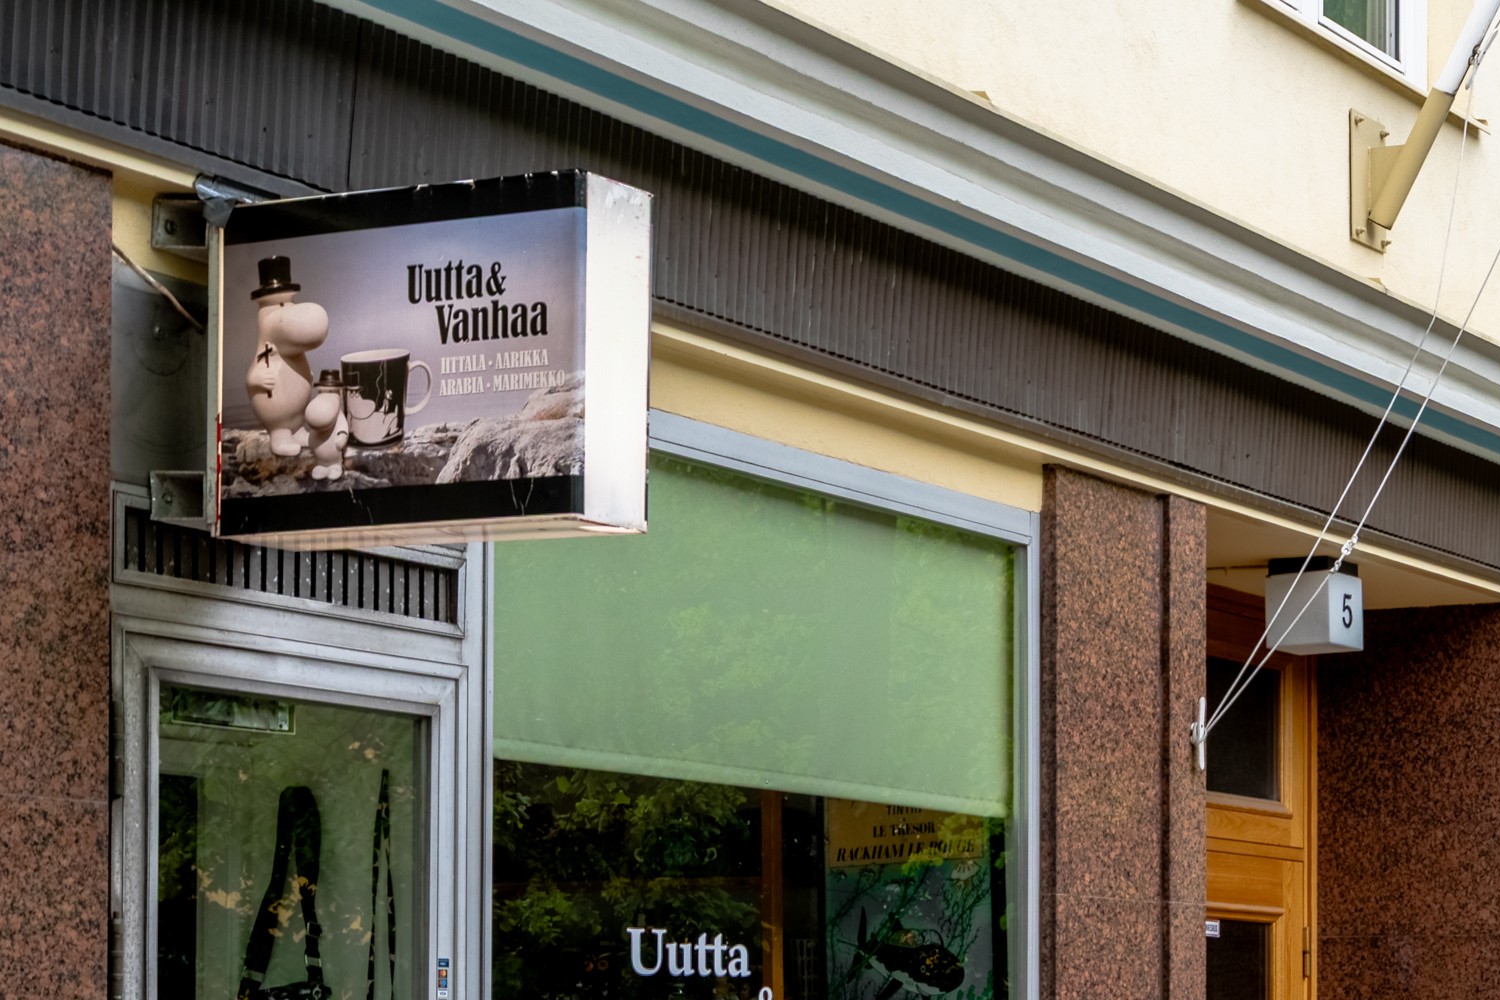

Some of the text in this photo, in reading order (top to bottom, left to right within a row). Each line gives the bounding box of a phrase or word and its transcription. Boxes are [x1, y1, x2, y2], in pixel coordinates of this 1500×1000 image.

[435, 300, 548, 345] Vanhaa
[440, 349, 549, 375] IITTALA AARIKKA
[439, 370, 566, 396] ARABIA MARIMEKKO
[1342, 593, 1353, 629] 5
[873, 826, 887, 838] LE
[836, 843, 905, 862] RACKHAM
[626, 927, 751, 977] Uutta
